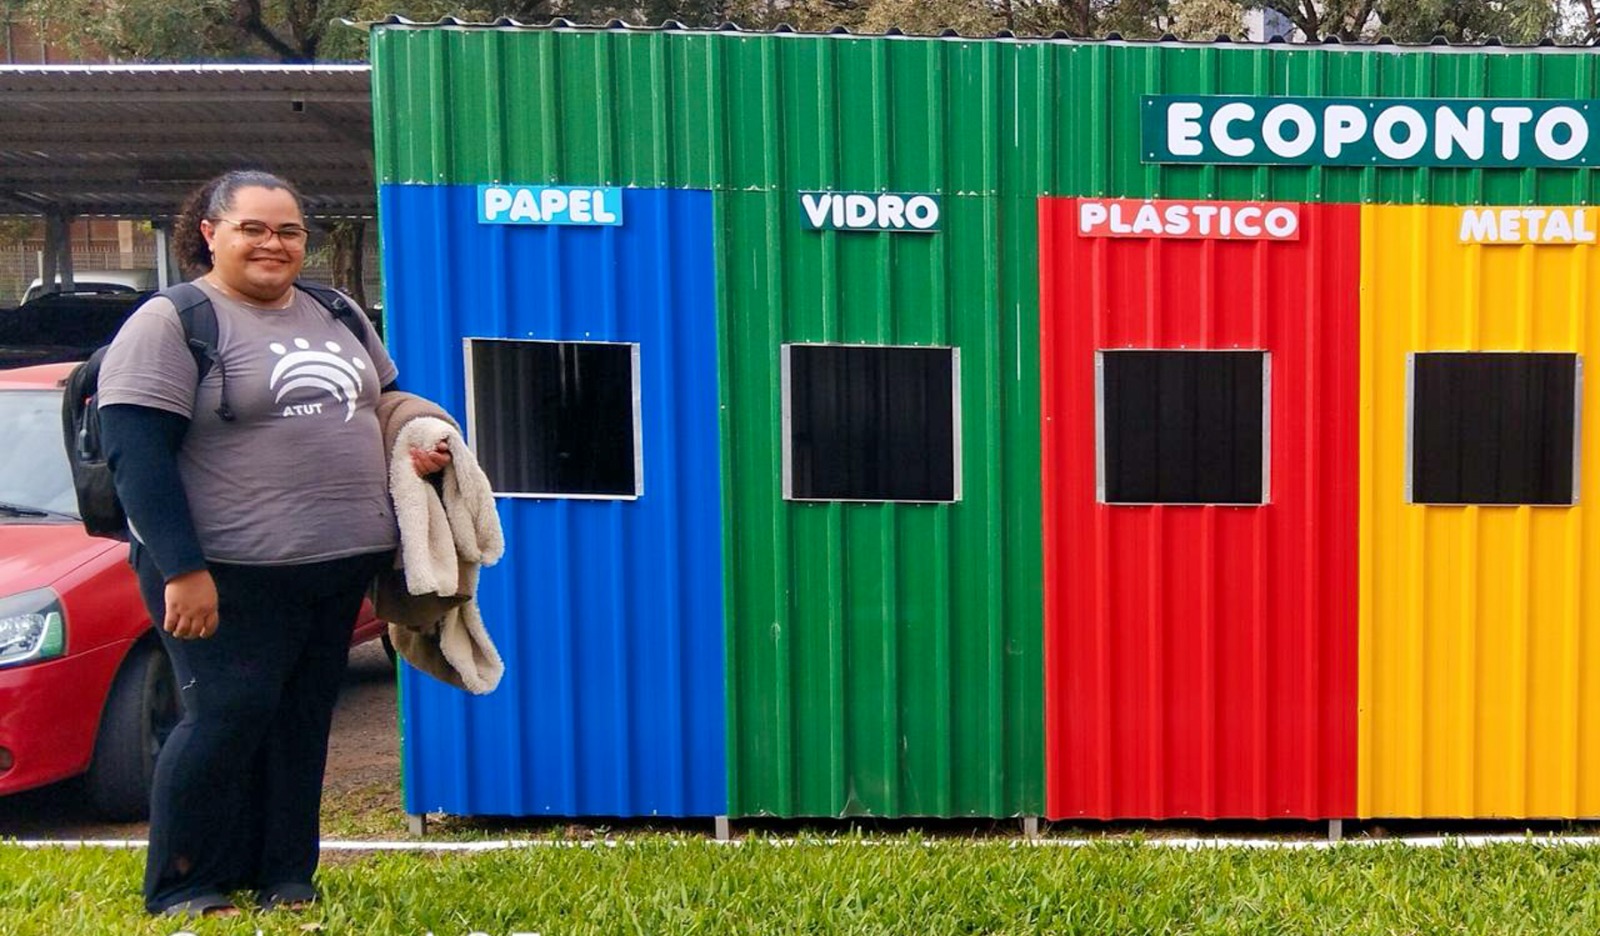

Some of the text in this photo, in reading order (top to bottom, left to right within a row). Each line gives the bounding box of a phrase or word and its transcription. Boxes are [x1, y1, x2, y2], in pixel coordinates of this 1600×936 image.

[1166, 102, 1589, 161] ECOPONTO
[485, 188, 616, 223] PAPEL
[801, 194, 939, 229] VIDRO
[1460, 209, 1595, 242] METAL
[282, 403, 323, 417] ATUT
